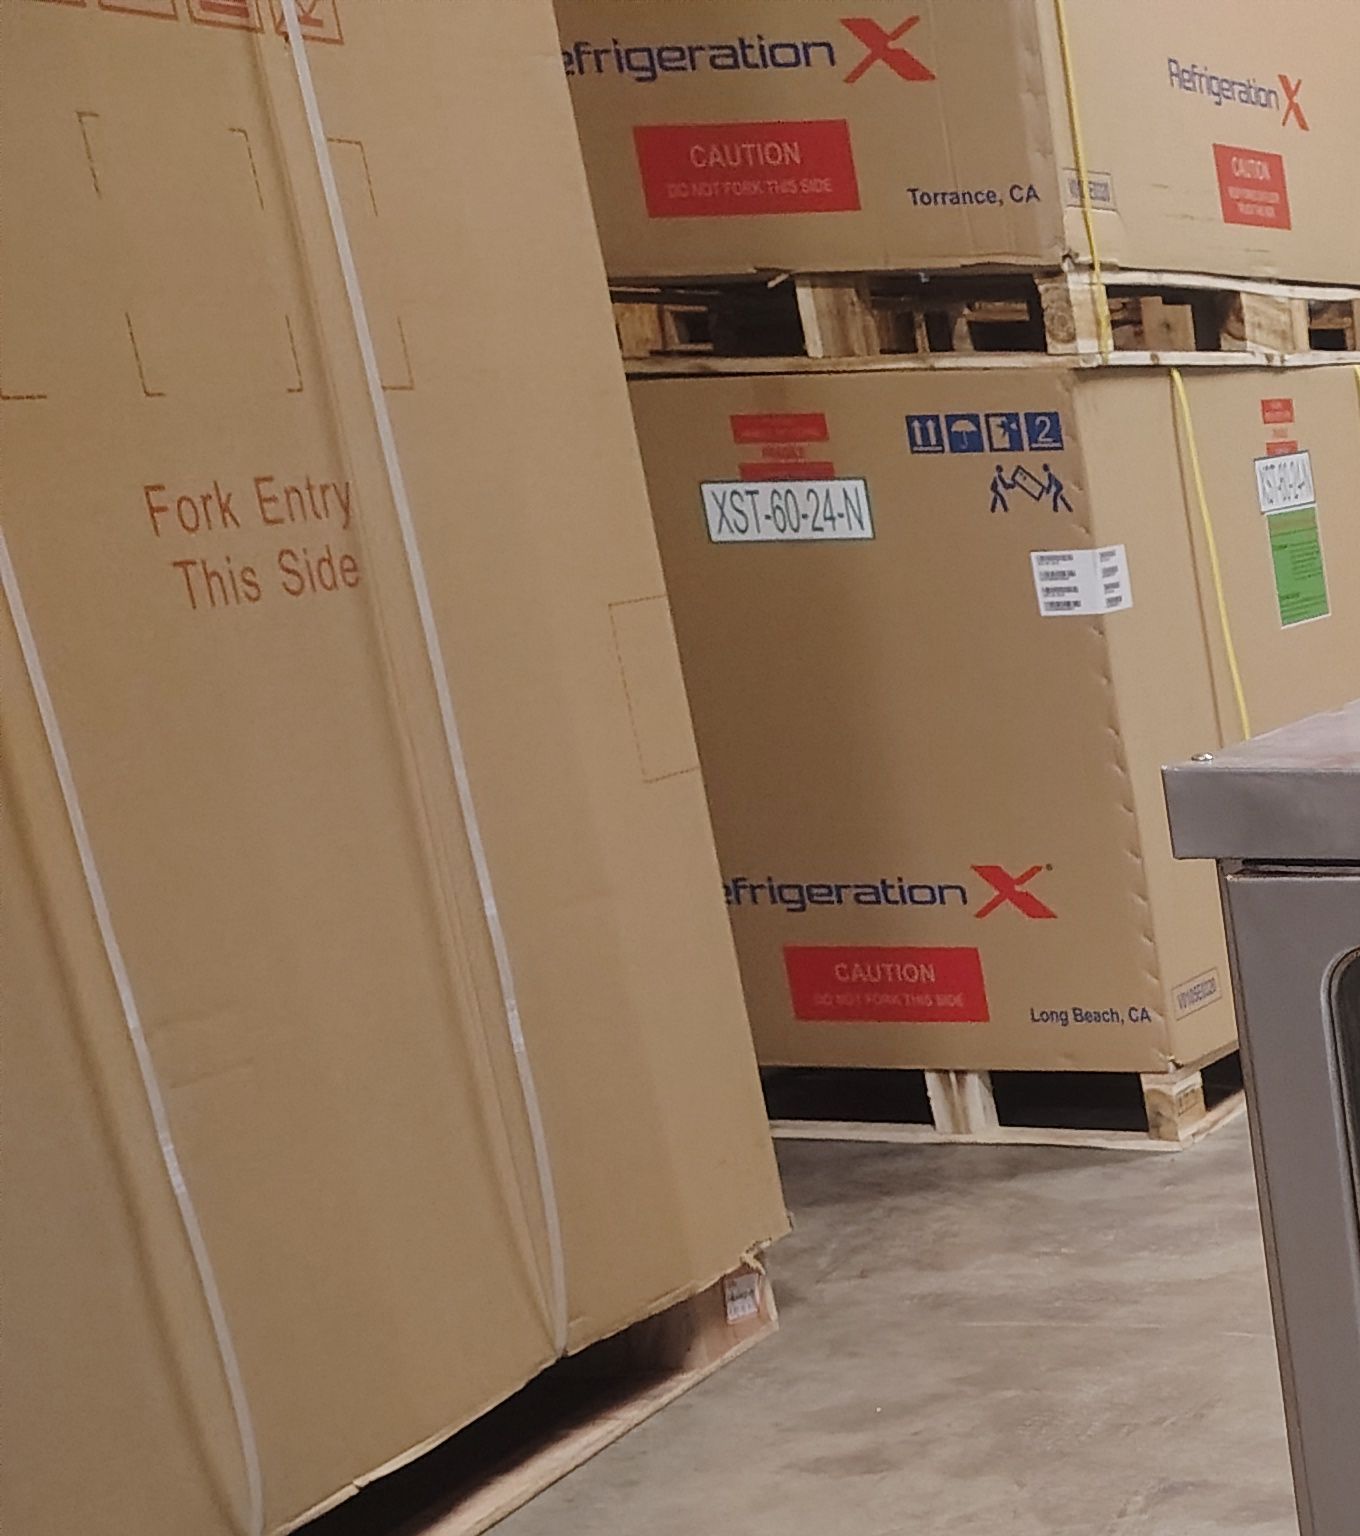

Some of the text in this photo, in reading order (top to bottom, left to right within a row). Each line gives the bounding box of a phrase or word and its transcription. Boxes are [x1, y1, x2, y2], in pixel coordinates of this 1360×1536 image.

[1167, 57, 1280, 111] Refrigeration
[689, 141, 802, 168] CAUTION
[801, 177, 832, 193] SIDE
[907, 184, 1004, 208] Torrance,
[1010, 183, 1040, 203] CA
[143, 475, 350, 538] Fork Entry
[711, 487, 866, 535] XST-60-24-N
[172, 543, 360, 611] This Side
[834, 962, 936, 983] CAUTION
[1030, 1006, 1151, 1026] Long Beach, CA
